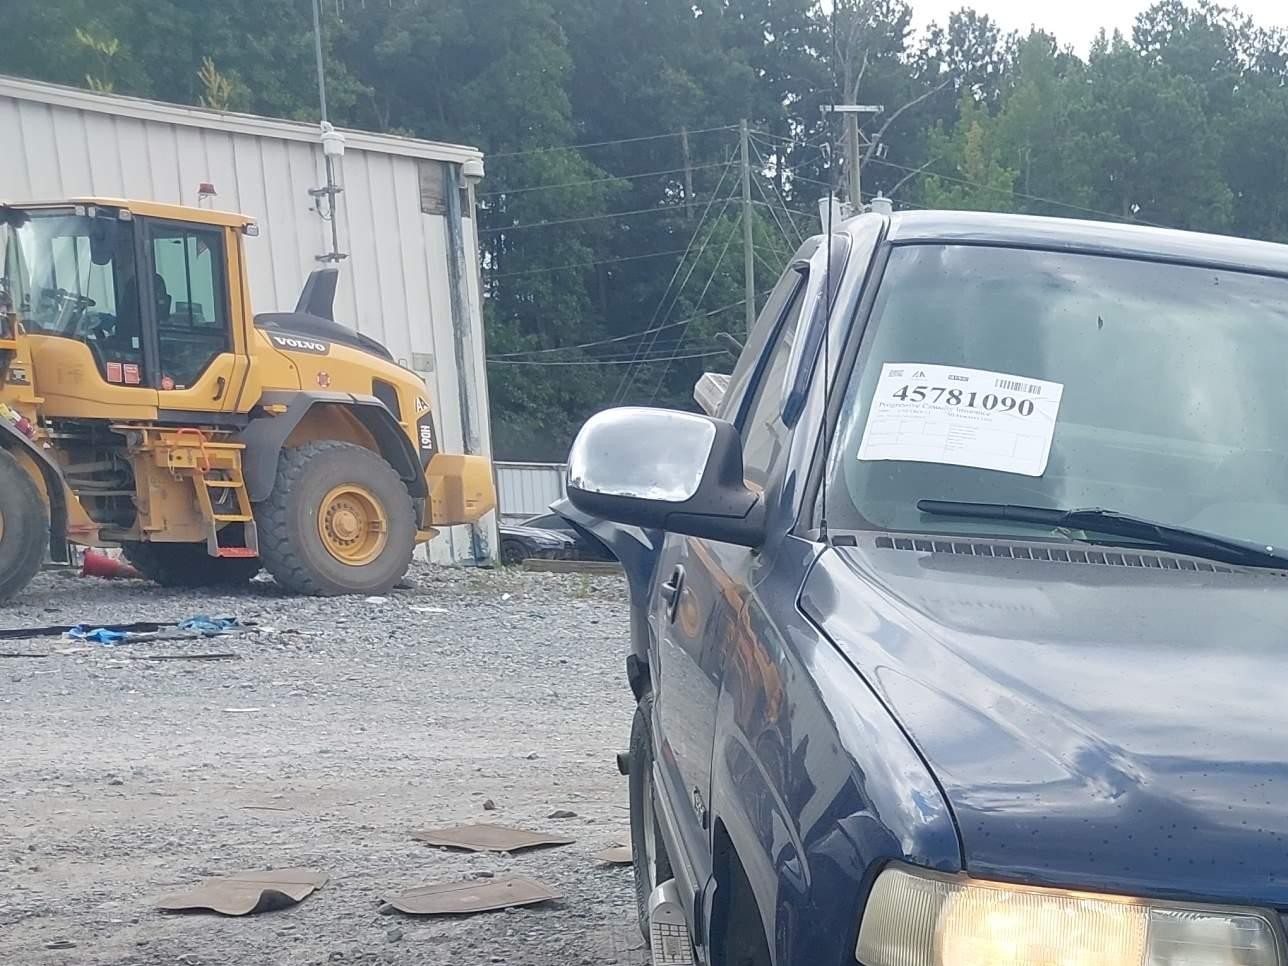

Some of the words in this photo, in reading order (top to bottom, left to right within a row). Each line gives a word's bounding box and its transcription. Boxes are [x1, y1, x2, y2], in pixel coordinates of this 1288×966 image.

[273, 336, 326, 352] VOLVO
[892, 384, 1035, 417] 45781090
[420, 425, 433, 450] L90H
